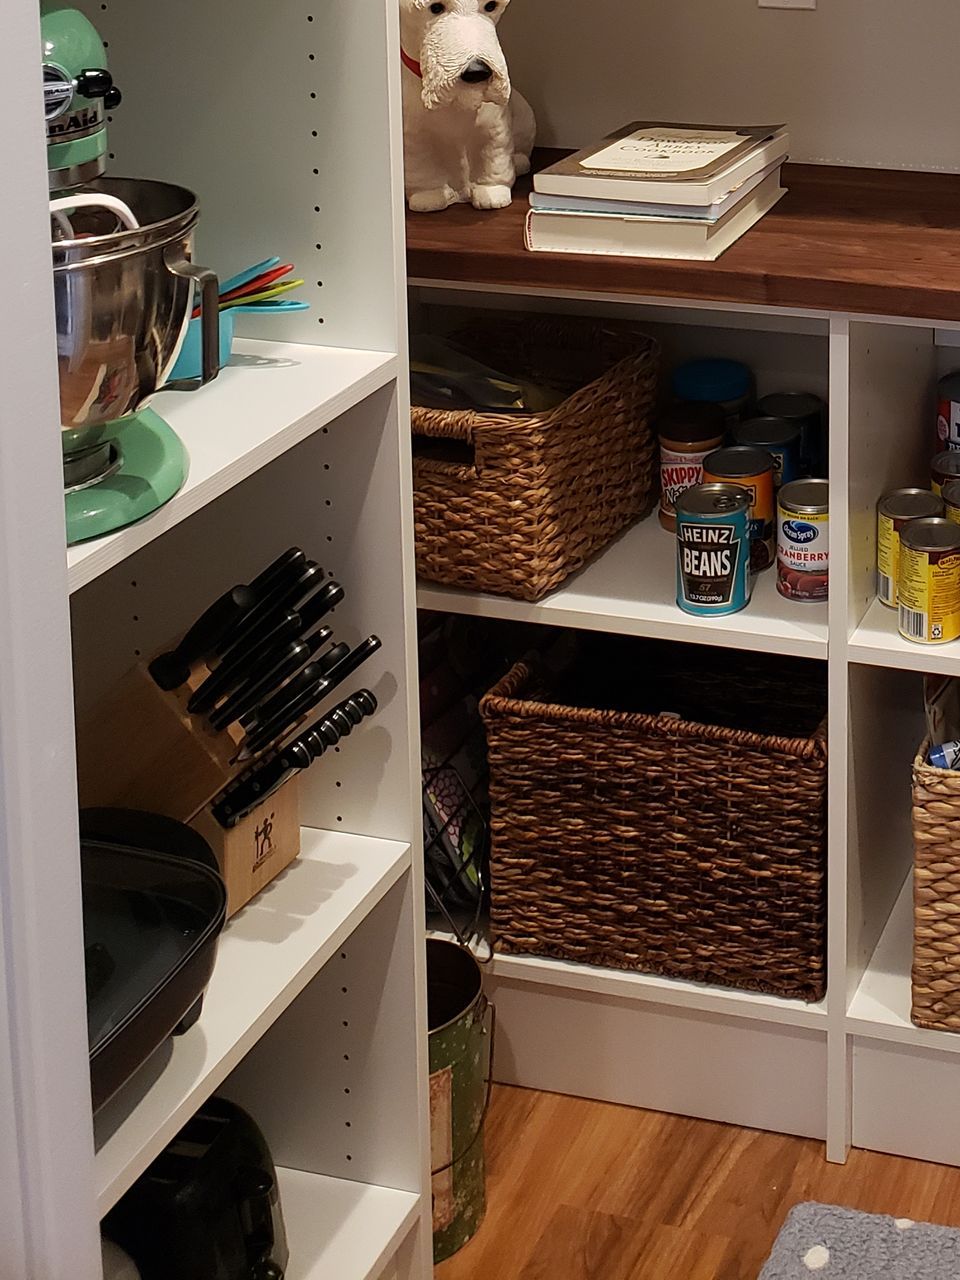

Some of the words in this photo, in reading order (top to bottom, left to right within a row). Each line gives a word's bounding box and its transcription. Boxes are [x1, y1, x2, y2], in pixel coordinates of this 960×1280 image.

[662, 466, 702, 488] SKIPPY
[683, 527, 732, 545] HEINZ
[797, 529, 815, 541] Spray
[683, 548, 732, 577] BEANS
[790, 560, 807, 568] SAUCE
